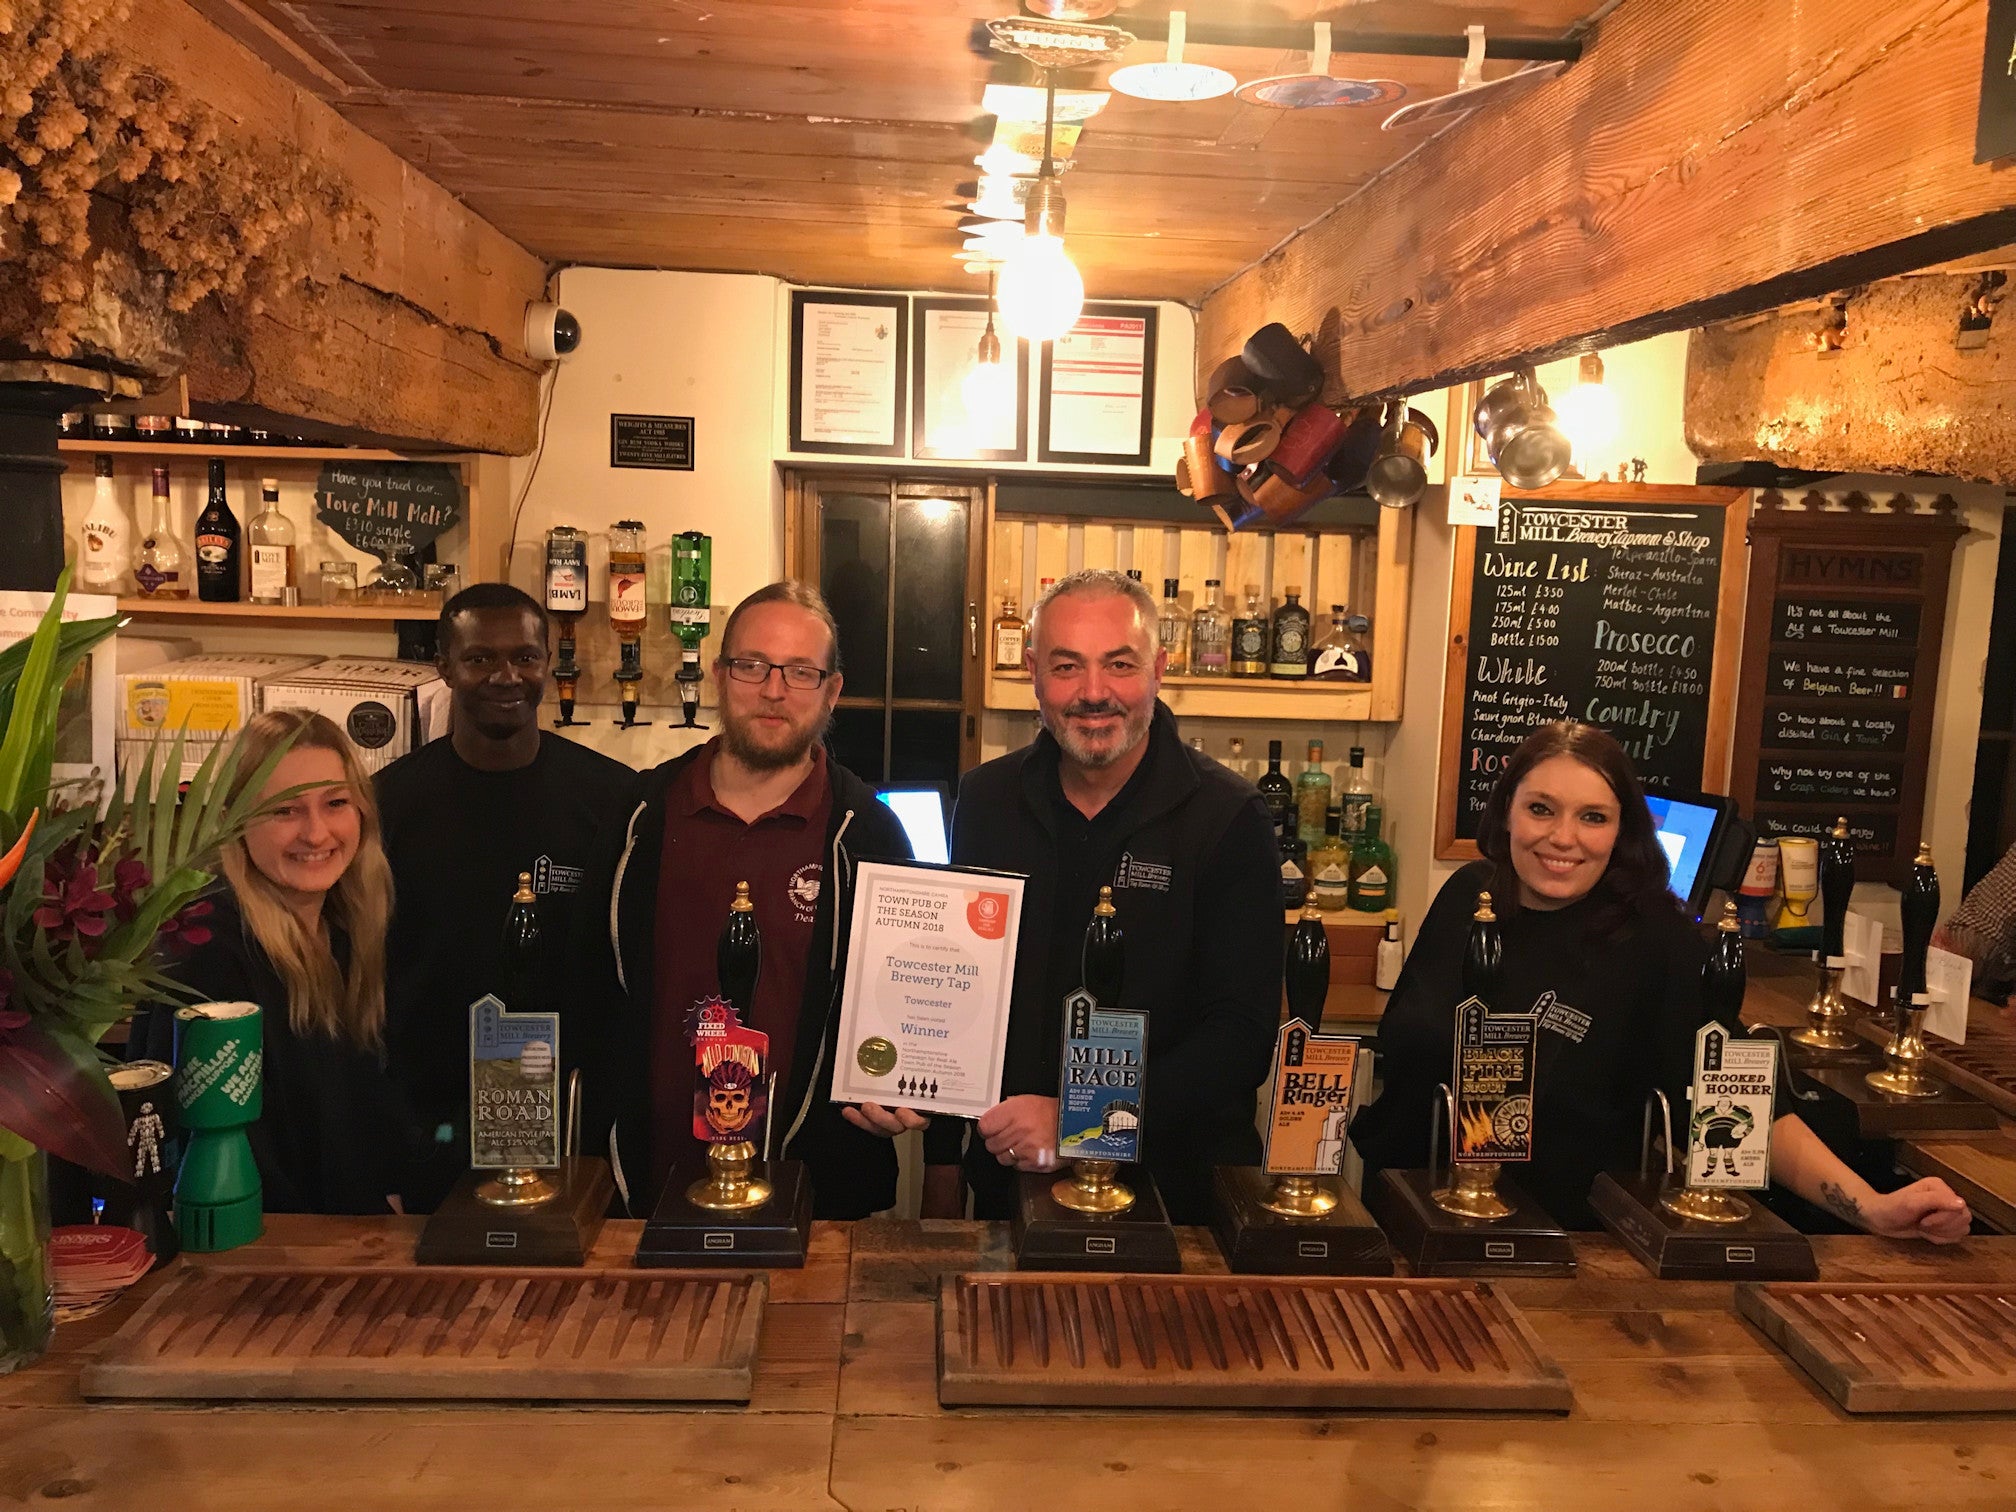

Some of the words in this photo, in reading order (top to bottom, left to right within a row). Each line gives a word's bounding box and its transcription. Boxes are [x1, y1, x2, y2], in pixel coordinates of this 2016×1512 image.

[332, 470, 357, 484] Have
[358, 478, 382, 499] you
[324, 492, 361, 514] Tove
[366, 497, 398, 519] Mill
[1522, 513, 1628, 529] TOWCESTER
[376, 524, 411, 544] single
[1520, 526, 1566, 541] MILL
[1663, 531, 1675, 545] &
[1674, 531, 1710, 553] Shop
[1484, 553, 1539, 578] Wine
[1790, 553, 1913, 581] HYMNS
[1608, 565, 1642, 580] Shiraz
[1651, 567, 1704, 585] Australia
[1496, 585, 1527, 597] 125ml
[1603, 584, 1637, 598] Merlot
[9, 608, 79, 620] Commity
[1495, 601, 1526, 614] 175ml
[1603, 598, 1643, 613] Malbec
[1652, 603, 1710, 624] Argentina
[1787, 605, 1804, 617] It's
[1809, 608, 1823, 617] not
[1842, 609, 1867, 621] about
[1876, 612, 1892, 622] the
[1491, 616, 1522, 628] 250ml
[1787, 622, 1804, 632] ALE
[1812, 625, 1823, 634] at
[1828, 624, 1877, 636] Towcester
[1879, 628, 1898, 638] Mill
[1491, 632, 1525, 647] Bottle
[1597, 659, 1629, 673] 200ml
[1631, 661, 1664, 678] bottle
[1784, 660, 1801, 673] We
[1806, 662, 1830, 674] have
[1835, 667, 1842, 675] a
[1846, 666, 1866, 679] fine
[1595, 675, 1627, 689] 750ml
[1633, 679, 1667, 694] bottle
[1783, 678, 1794, 687] of
[1803, 678, 1841, 696] Belgian
[1849, 682, 1882, 696] Beer!!
[1472, 691, 1497, 703] Pinot
[1502, 692, 1534, 713] Grigio
[1543, 694, 1568, 714] Italy
[1473, 708, 1524, 728] Sauvignon
[1584, 697, 1680, 746] Country
[1778, 712, 1792, 723] Or
[1798, 715, 1816, 725] how
[1819, 717, 1846, 727] about
[1852, 720, 1860, 728] a
[1471, 728, 1530, 744] Chardonn
[1470, 747, 1512, 775] Ros
[1770, 766, 1792, 780] Why
[1797, 766, 1815, 776] not
[1818, 767, 1832, 780] try
[1836, 770, 1853, 779] one
[1858, 770, 1870, 782] of
[1874, 770, 1890, 781] the
[1774, 781, 1781, 791] 6
[1853, 786, 1866, 796] we
[1870, 787, 1896, 797] have?
[1768, 820, 1787, 831] You
[1793, 824, 1821, 833] could
[1851, 827, 1874, 839] enjoy
[879, 894, 909, 905] TOWN
[912, 898, 932, 908] PUB
[934, 901, 948, 909] OF
[877, 906, 897, 915] THE
[899, 908, 938, 920] SEASON
[876, 918, 921, 929] AUTUMN
[922, 923, 944, 932] 2018
[886, 956, 951, 973] Towcester
[955, 964, 979, 976] Mill
[890, 971, 943, 989] Brewery
[947, 978, 971, 991] Tap
[905, 995, 952, 1008] Towcester
[901, 1022, 949, 1038] Winner
[1091, 1019, 1139, 1028] TOWCESTER
[1504, 1033, 1530, 1041] Brewery
[1071, 1046, 1138, 1067] MILL
[1463, 1048, 1524, 1062] BLACK
[1724, 1050, 1770, 1058] TOWCESTER
[1069, 1067, 1137, 1087] RACE
[1463, 1063, 1524, 1081] FIRE
[1702, 1074, 1766, 1083] CROOKED
[1284, 1073, 1347, 1091] BELL
[1462, 1082, 1506, 1093] STOUT
[1705, 1084, 1772, 1095] HOOKER
[478, 1089, 551, 1104] ROMAN
[478, 1105, 552, 1121] ROAD
[479, 1130, 517, 1138] AMERICAN
